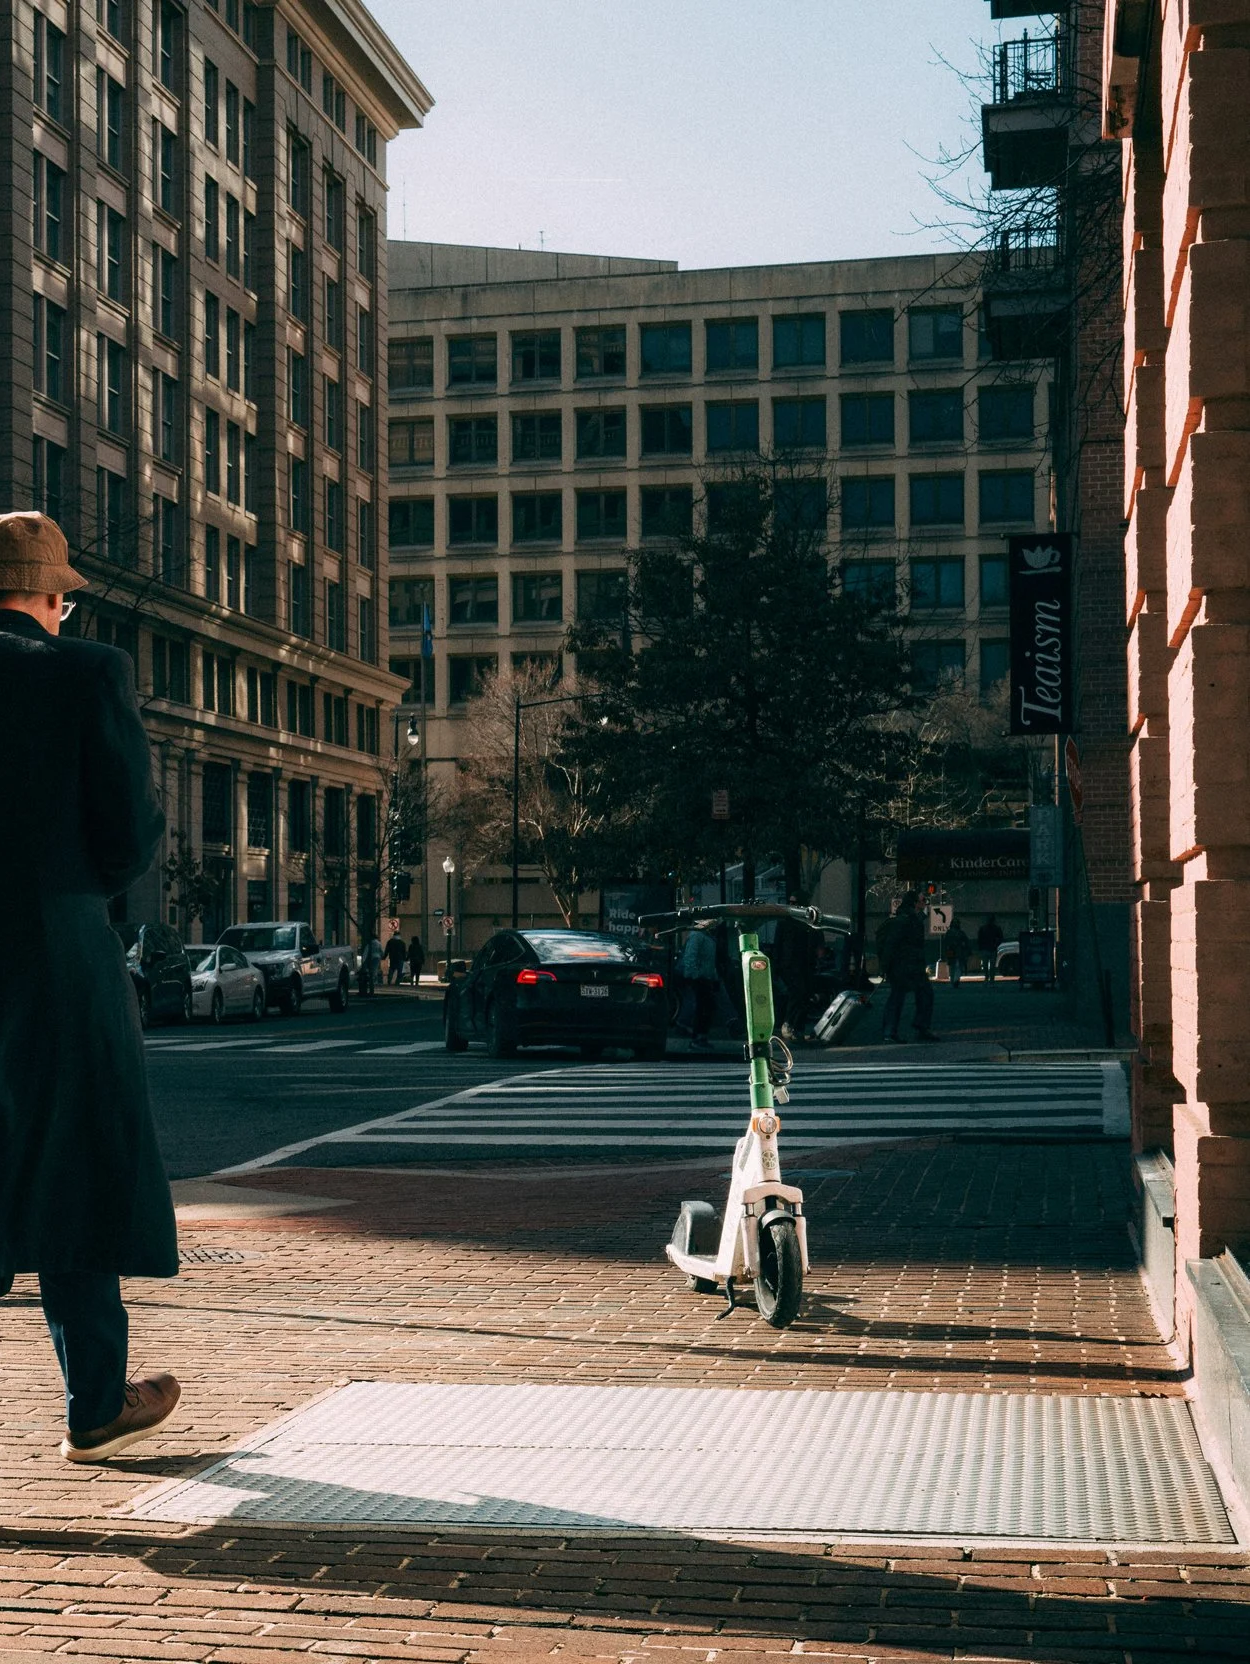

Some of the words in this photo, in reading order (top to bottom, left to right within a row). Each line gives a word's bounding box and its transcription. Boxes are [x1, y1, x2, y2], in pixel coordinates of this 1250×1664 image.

[1019, 599, 1063, 727] Teaism
[609, 908, 636, 920] Ride
[608, 921, 646, 938] happy
